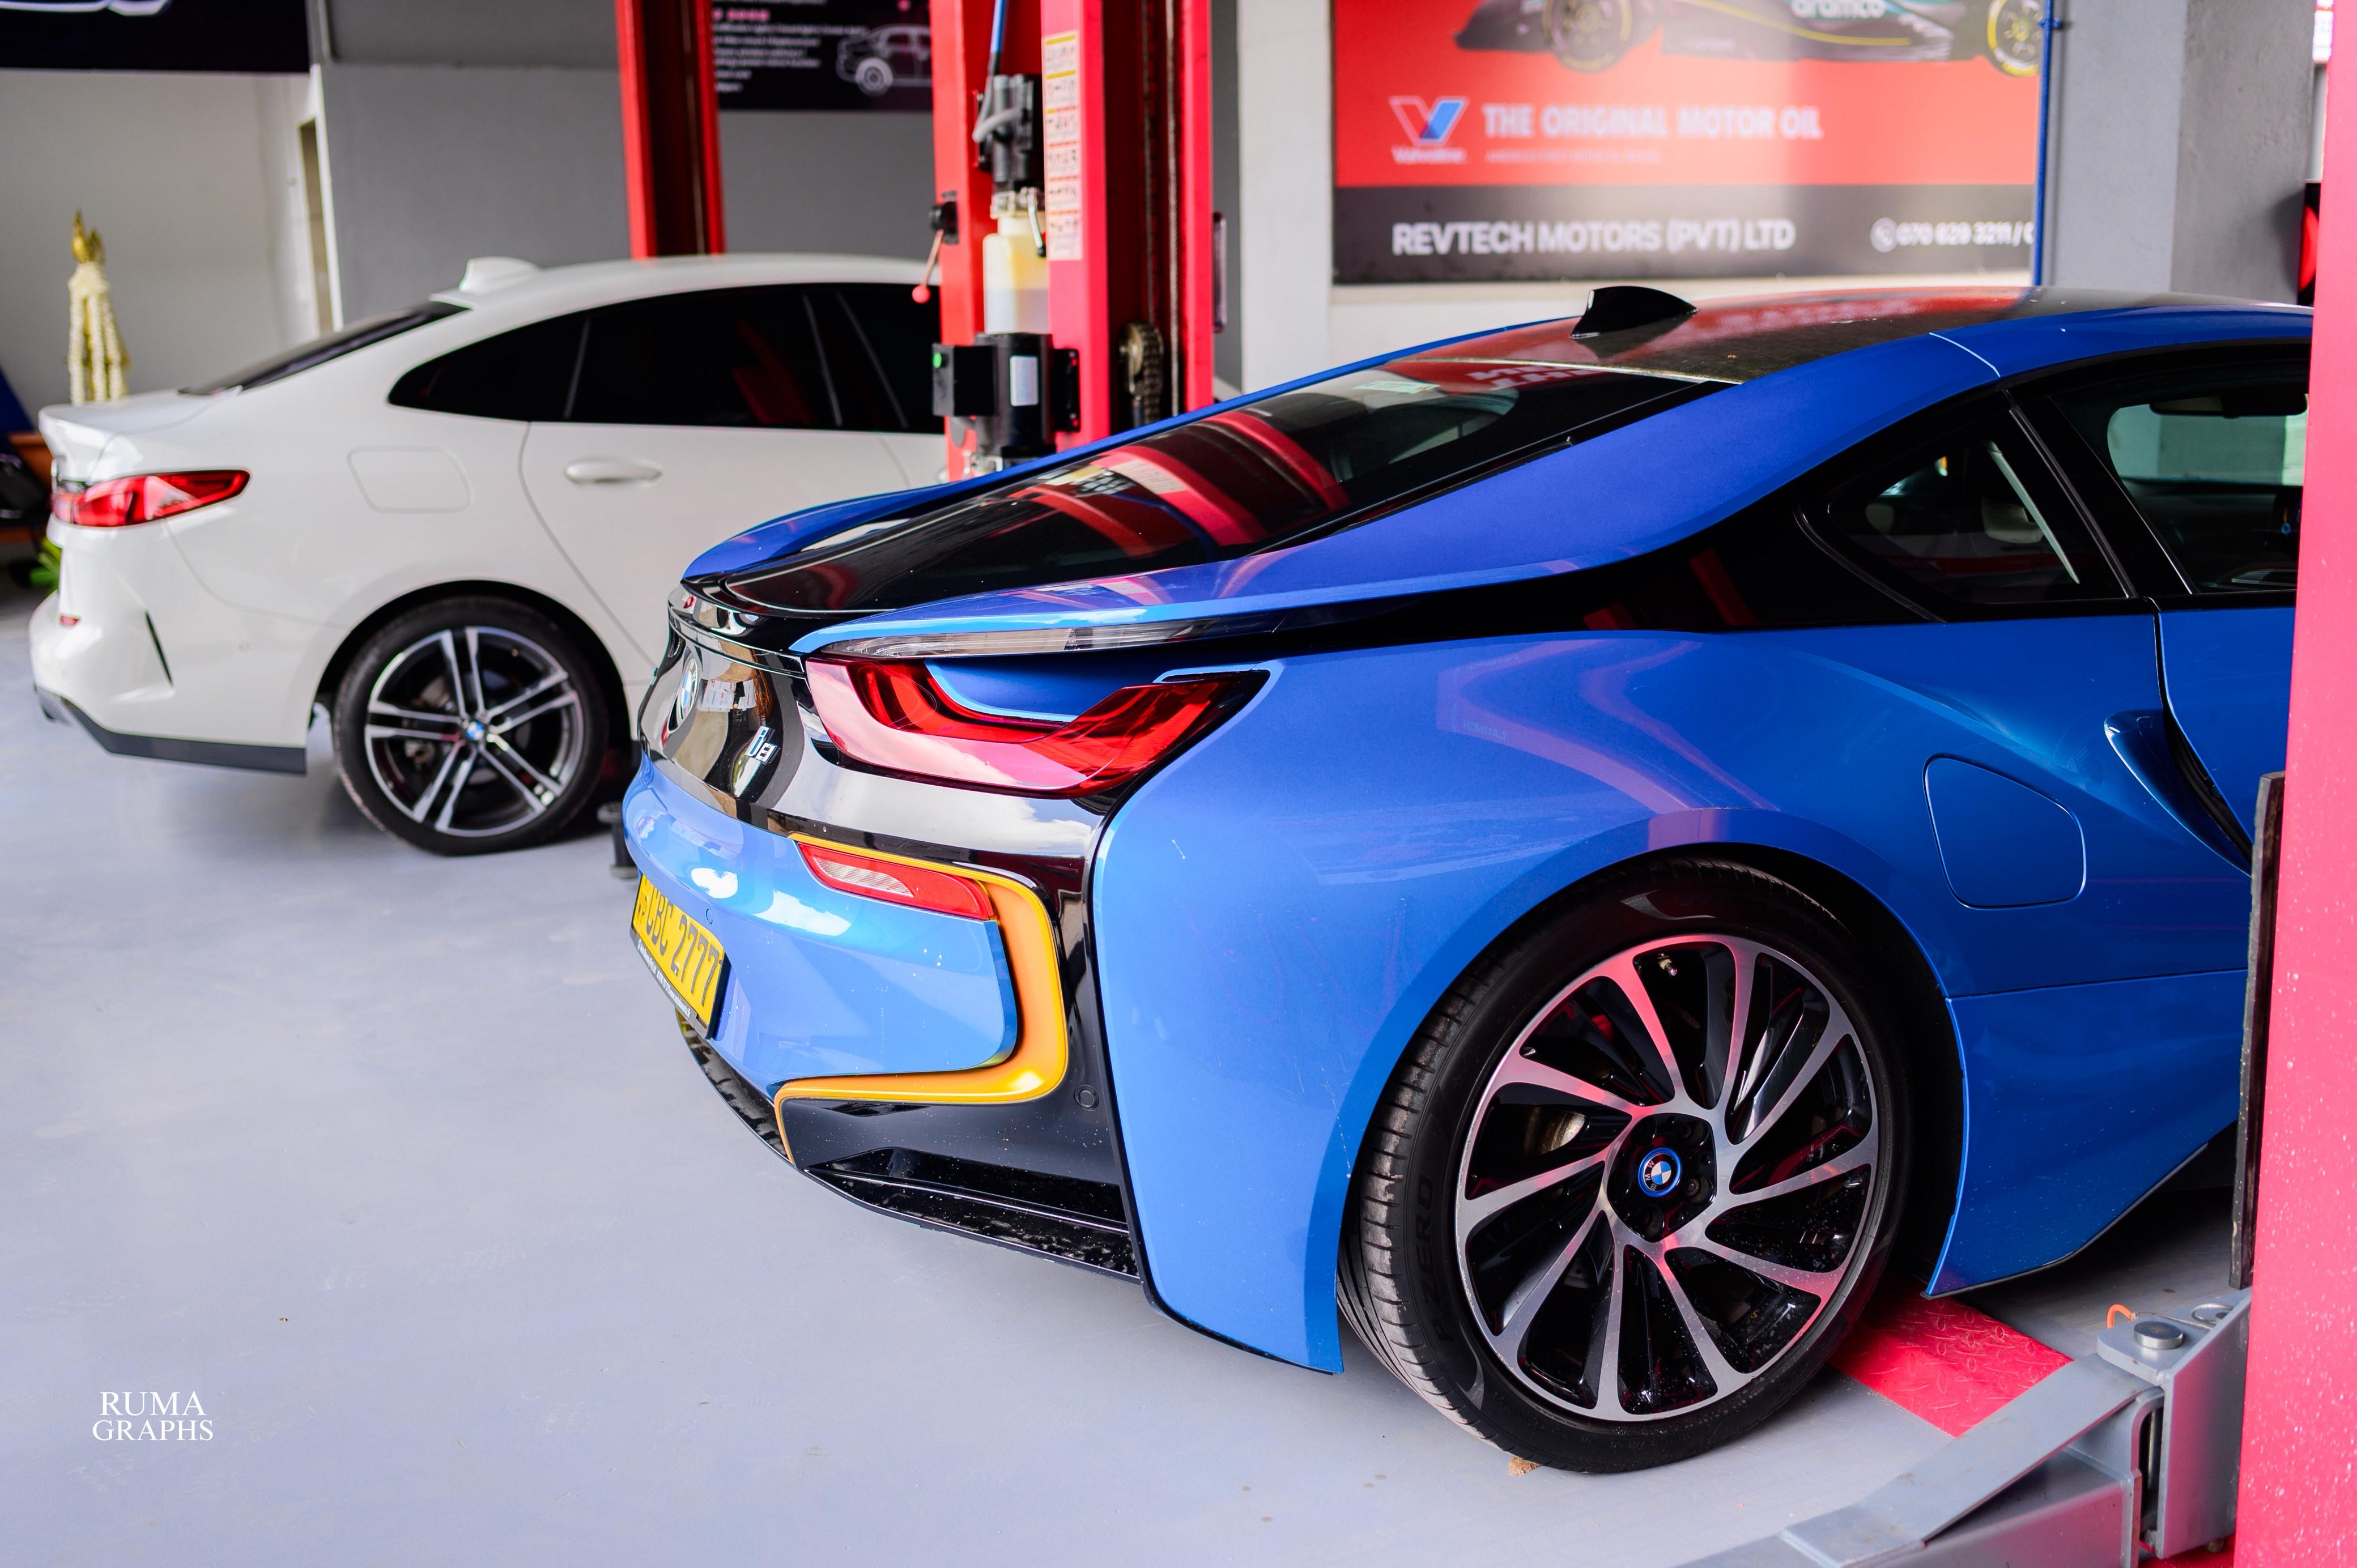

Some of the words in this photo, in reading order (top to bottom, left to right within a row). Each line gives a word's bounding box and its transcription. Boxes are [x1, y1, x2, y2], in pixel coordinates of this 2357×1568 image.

[1482, 104, 1535, 137] THE
[1542, 104, 1668, 137] ORIGINAL
[1678, 106, 1774, 138] MOTOR
[1780, 106, 1823, 139] OIL
[1392, 223, 1535, 255] REVTECH
[1537, 220, 1661, 253] MOTORS
[1666, 217, 1739, 253] (PVT)
[1743, 218, 1796, 250] LTD
[670, 914, 720, 1007] 2777
[1645, 1160, 1657, 1191] BMW
